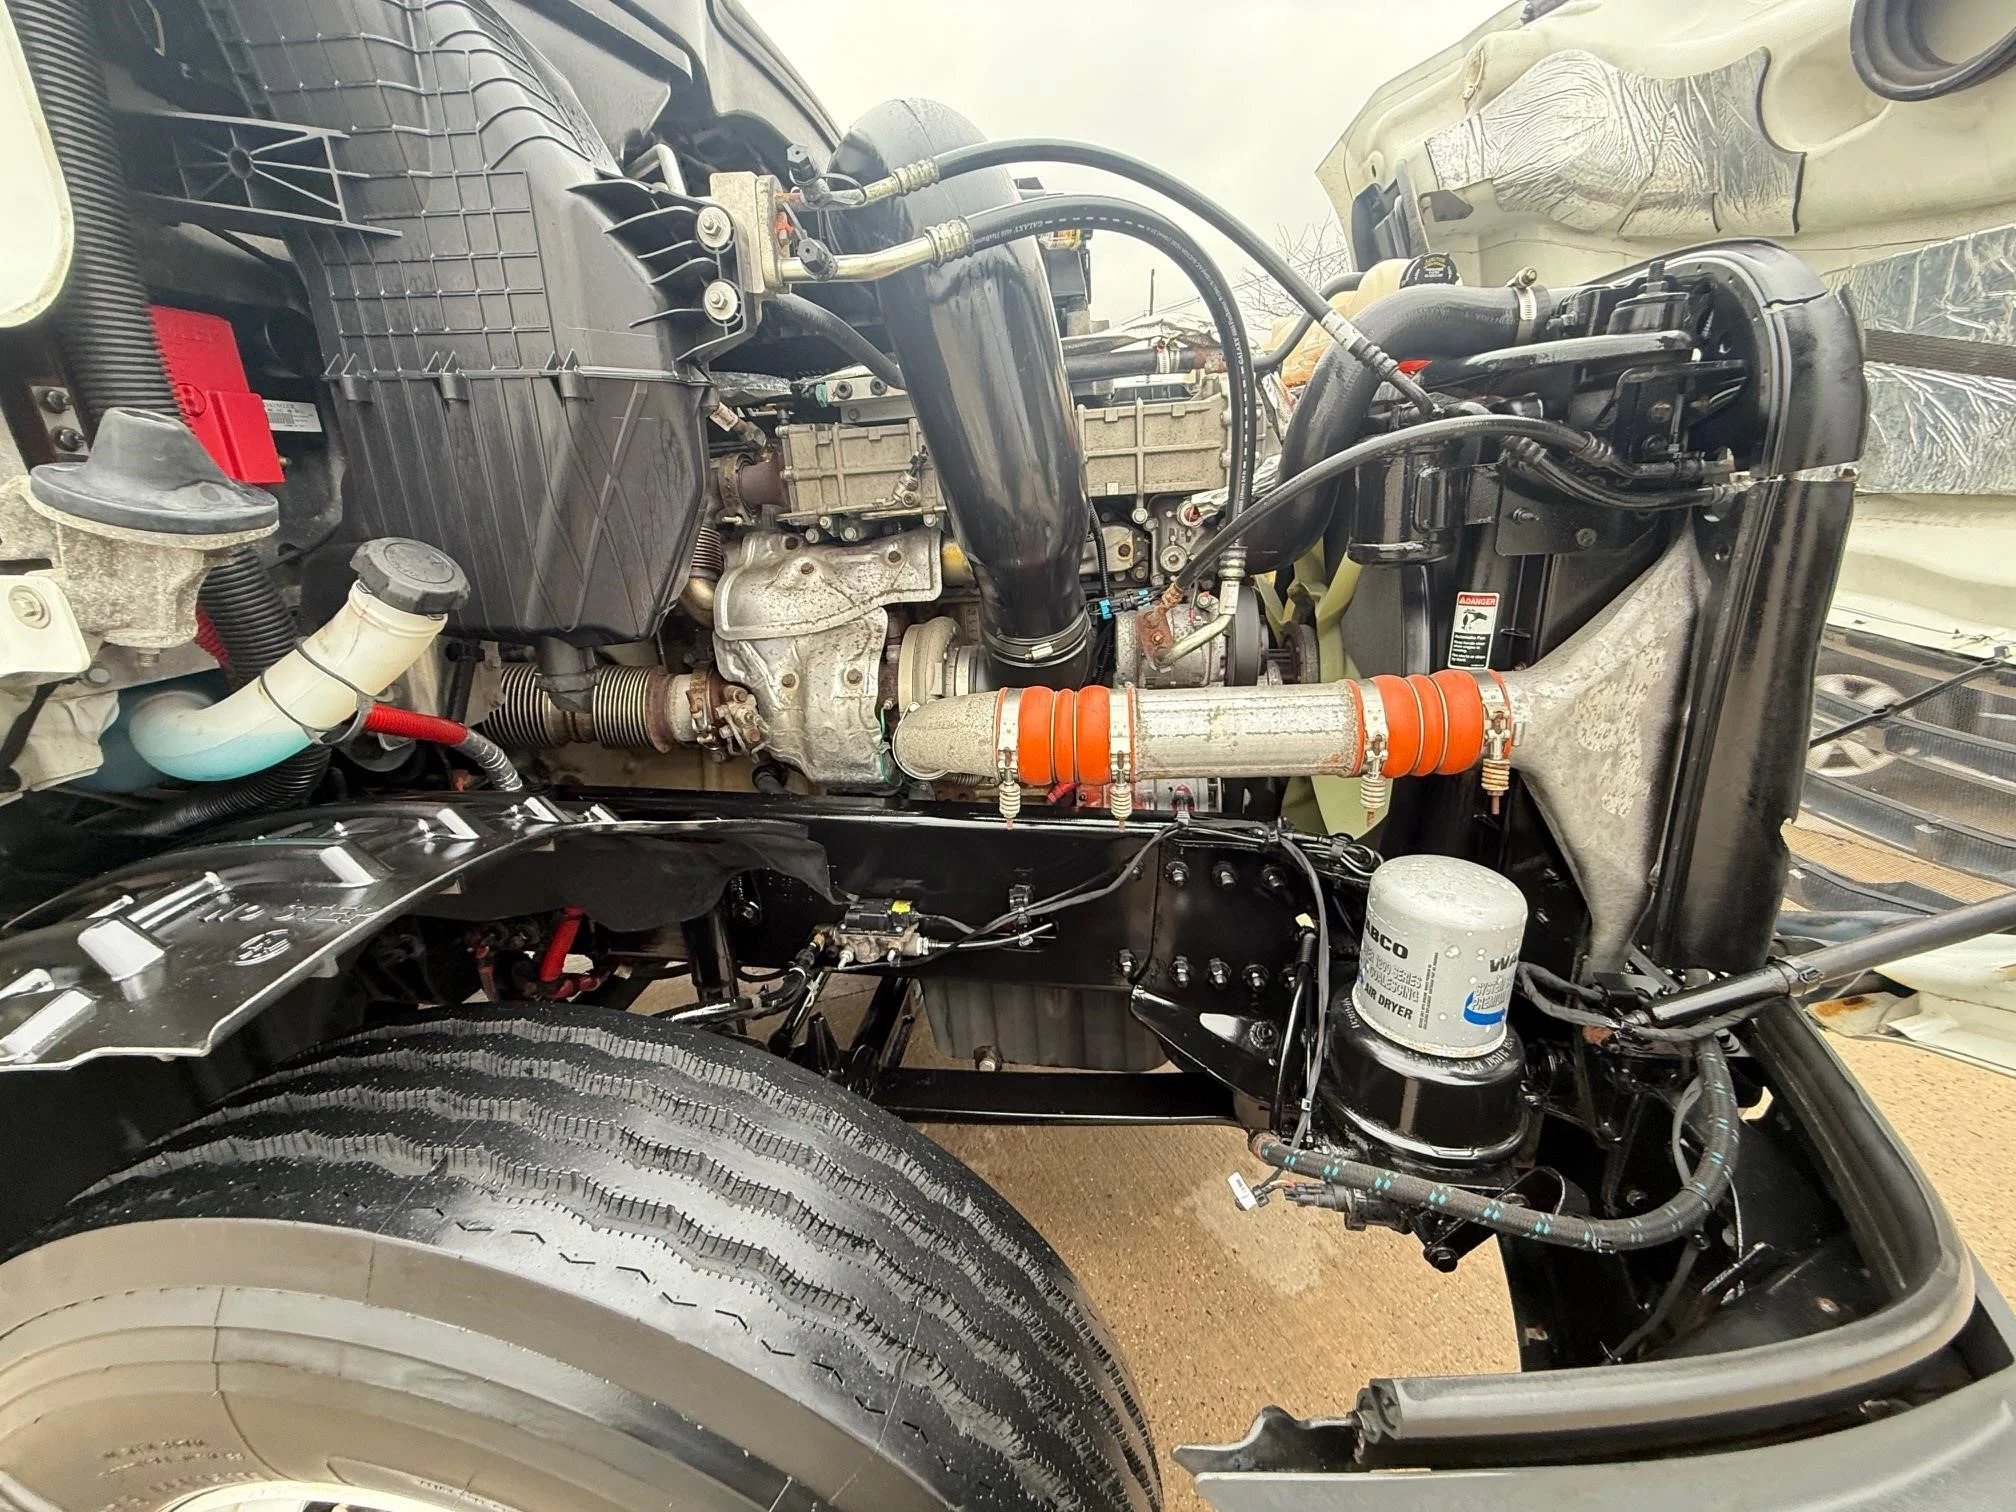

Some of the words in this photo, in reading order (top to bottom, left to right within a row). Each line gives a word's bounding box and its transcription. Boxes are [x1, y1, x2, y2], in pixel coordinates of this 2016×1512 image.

[1467, 597, 1496, 606] DANGER
[1393, 967, 1422, 989] SERIES
[1365, 982, 1377, 1000] AIR
[1378, 993, 1413, 1020] DRYER
